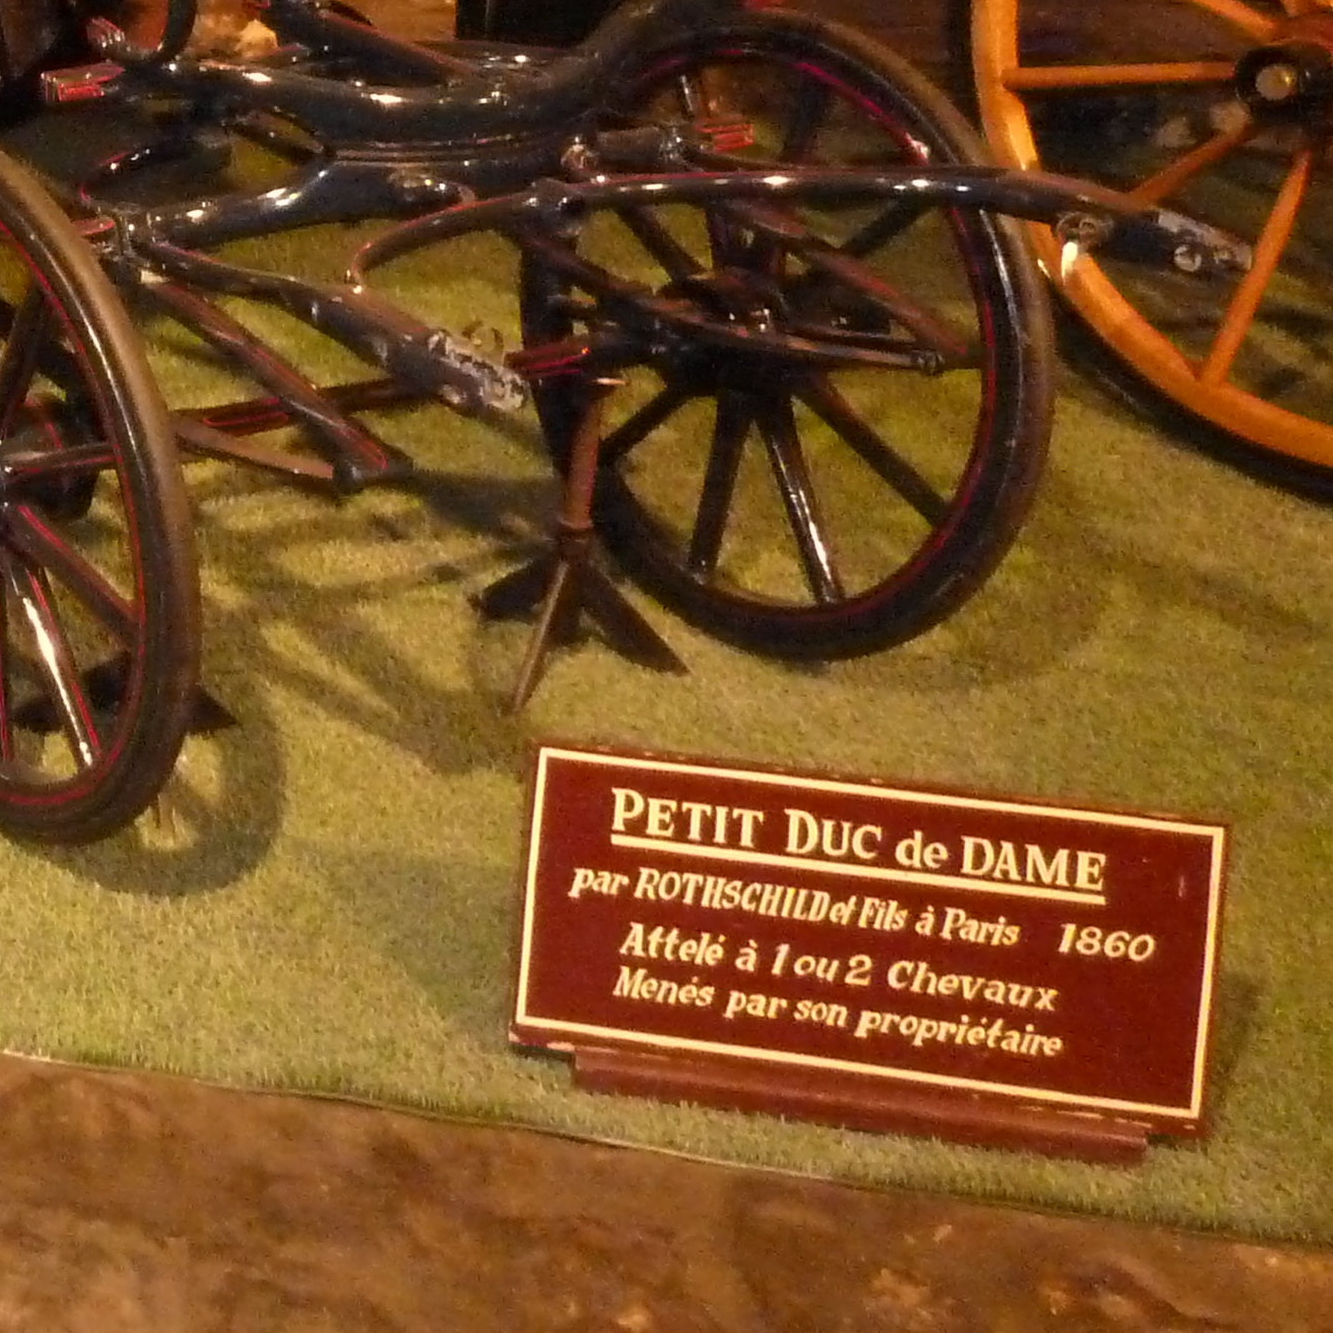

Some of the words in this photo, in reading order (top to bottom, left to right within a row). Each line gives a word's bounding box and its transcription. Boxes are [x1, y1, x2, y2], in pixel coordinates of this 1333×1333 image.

[611, 787, 764, 848] PETIT
[784, 808, 882, 859] DUC
[895, 831, 949, 869] de
[960, 835, 1107, 891] DAME
[568, 868, 629, 899] par
[634, 867, 831, 922] ROTHSCHILD
[829, 895, 857, 925] et
[859, 896, 908, 932] Fils
[915, 906, 935, 936] à
[939, 907, 1021, 946] Paris
[1058, 923, 1155, 961] 1860
[612, 966, 715, 1006] Menés
[723, 990, 787, 1018] par
[794, 999, 848, 1027] son
[854, 1009, 1064, 1057] propriétaire
[619, 922, 726, 966] Attelé
[735, 940, 758, 971] à
[771, 943, 790, 975] 1
[794, 954, 839, 981] ou
[844, 954, 873, 985] 2
[887, 960, 1058, 1011] Chevaux
